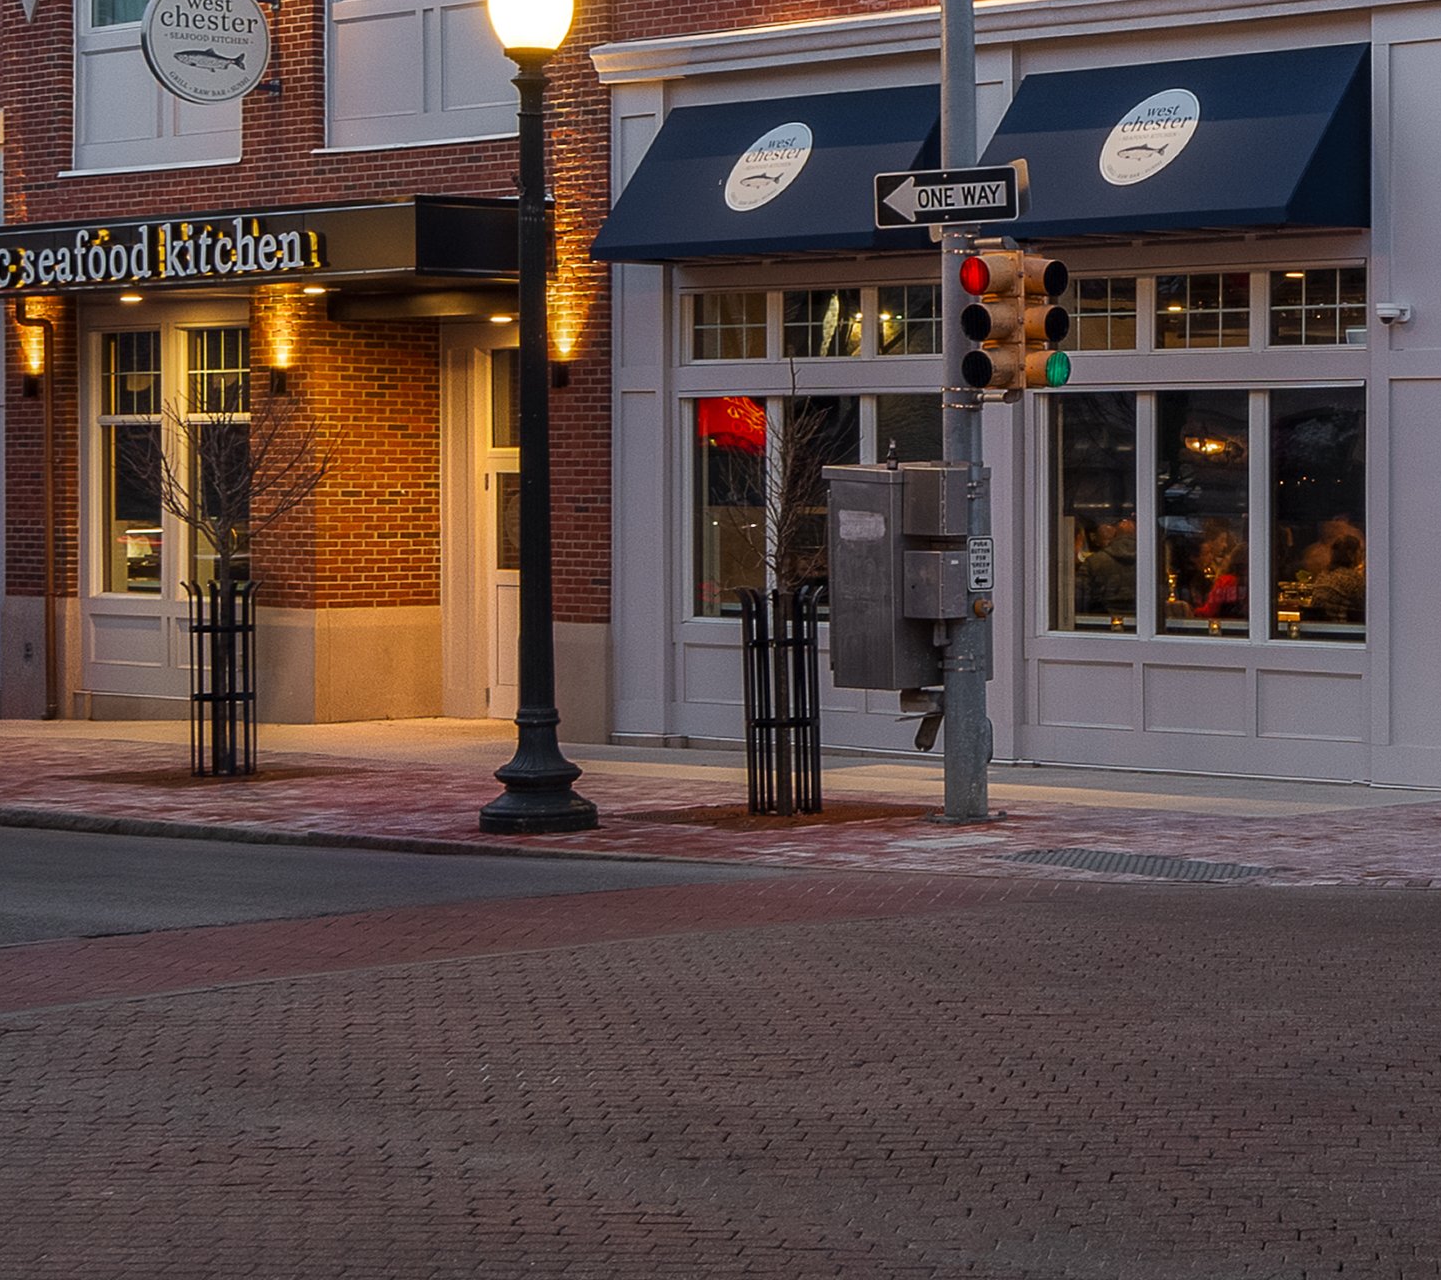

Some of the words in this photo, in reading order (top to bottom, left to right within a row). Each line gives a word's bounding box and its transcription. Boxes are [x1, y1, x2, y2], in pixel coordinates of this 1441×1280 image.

[160, 4, 259, 34] chester
[169, 31, 210, 42] SEAFOOD
[211, 34, 250, 45] KITCHEN
[1147, 104, 1180, 117] west
[1121, 115, 1192, 133] chester
[768, 136, 797, 149] west
[745, 146, 806, 163] chester
[917, 187, 956, 209] ONE
[961, 183, 1001, 207] WAY
[21, 224, 154, 285] seafood
[161, 216, 307, 277] kitchen
